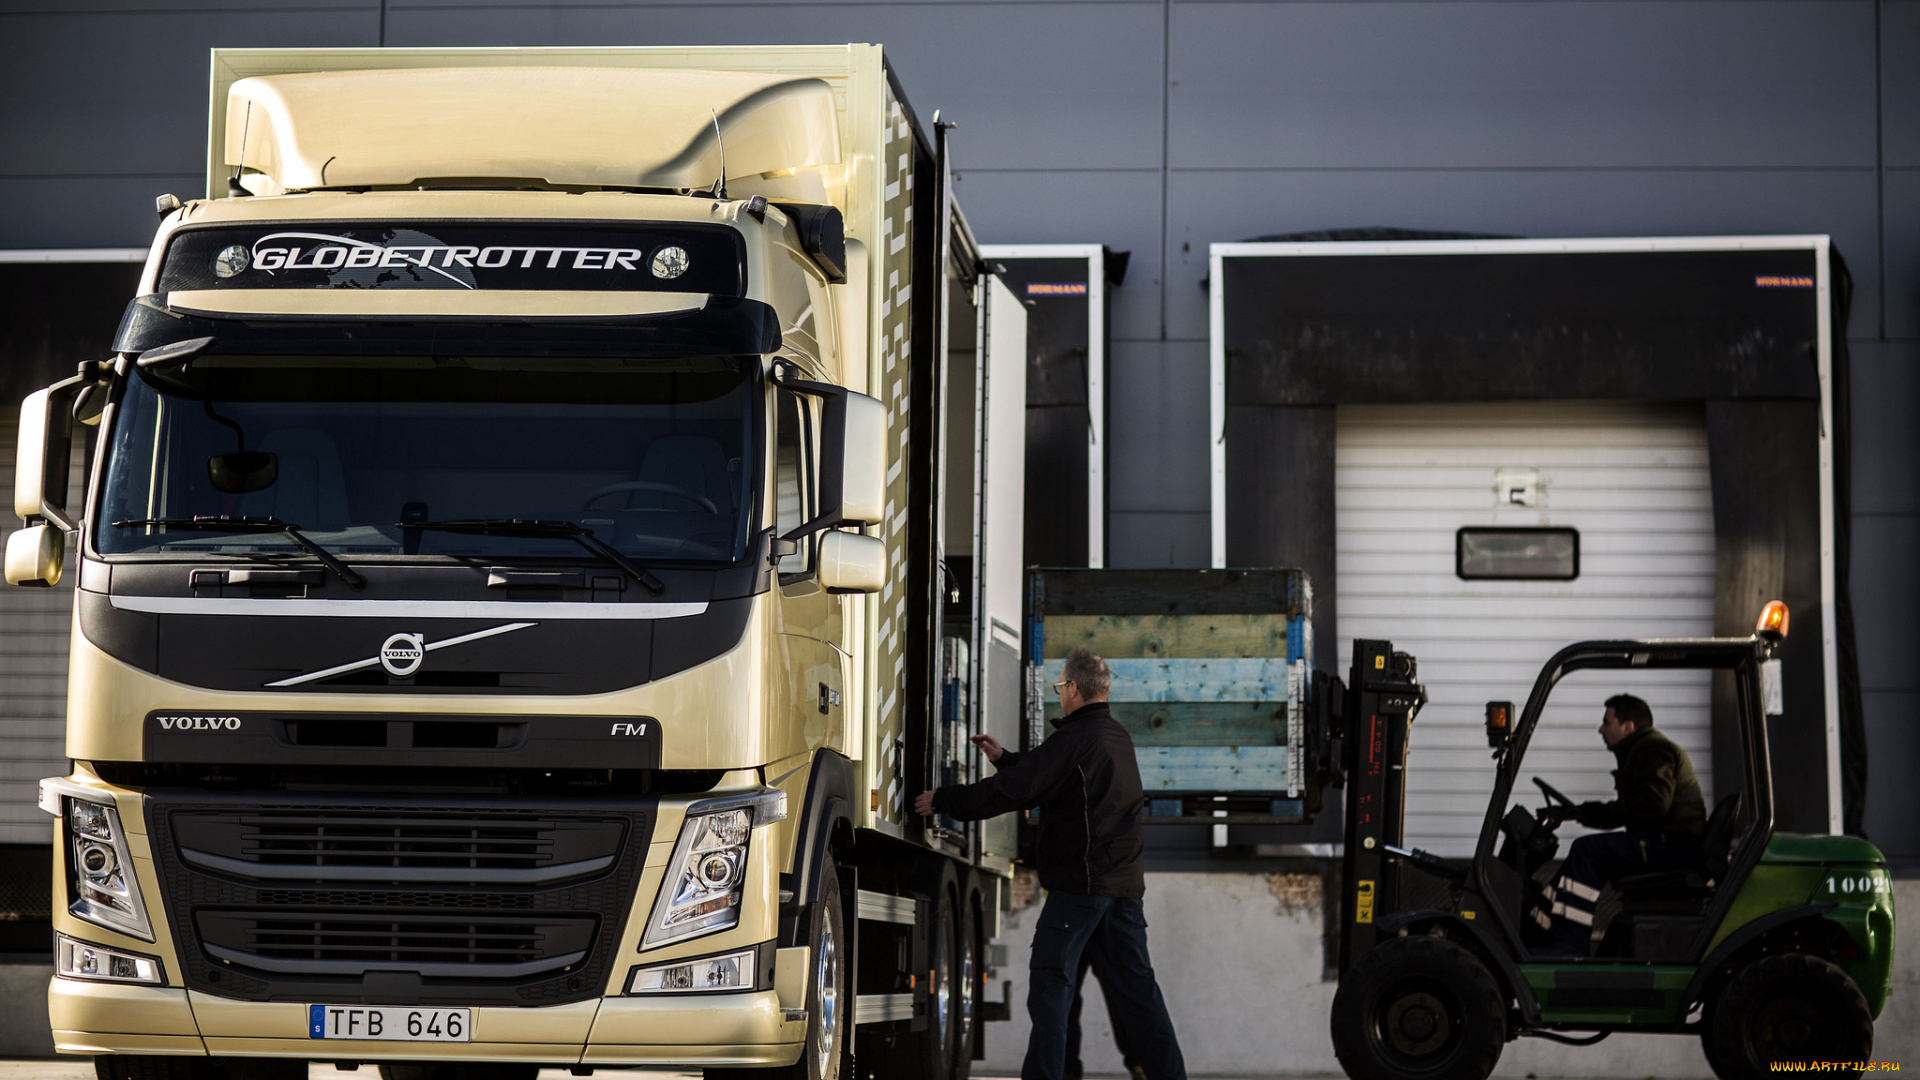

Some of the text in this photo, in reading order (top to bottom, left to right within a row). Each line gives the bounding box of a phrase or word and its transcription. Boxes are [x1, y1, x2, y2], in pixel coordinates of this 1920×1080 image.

[251, 245, 642, 271] GLOBETROTTER
[156, 716, 242, 730] VOLVO
[610, 723, 647, 736] FM
[329, 1009, 463, 1038] TFB 646
